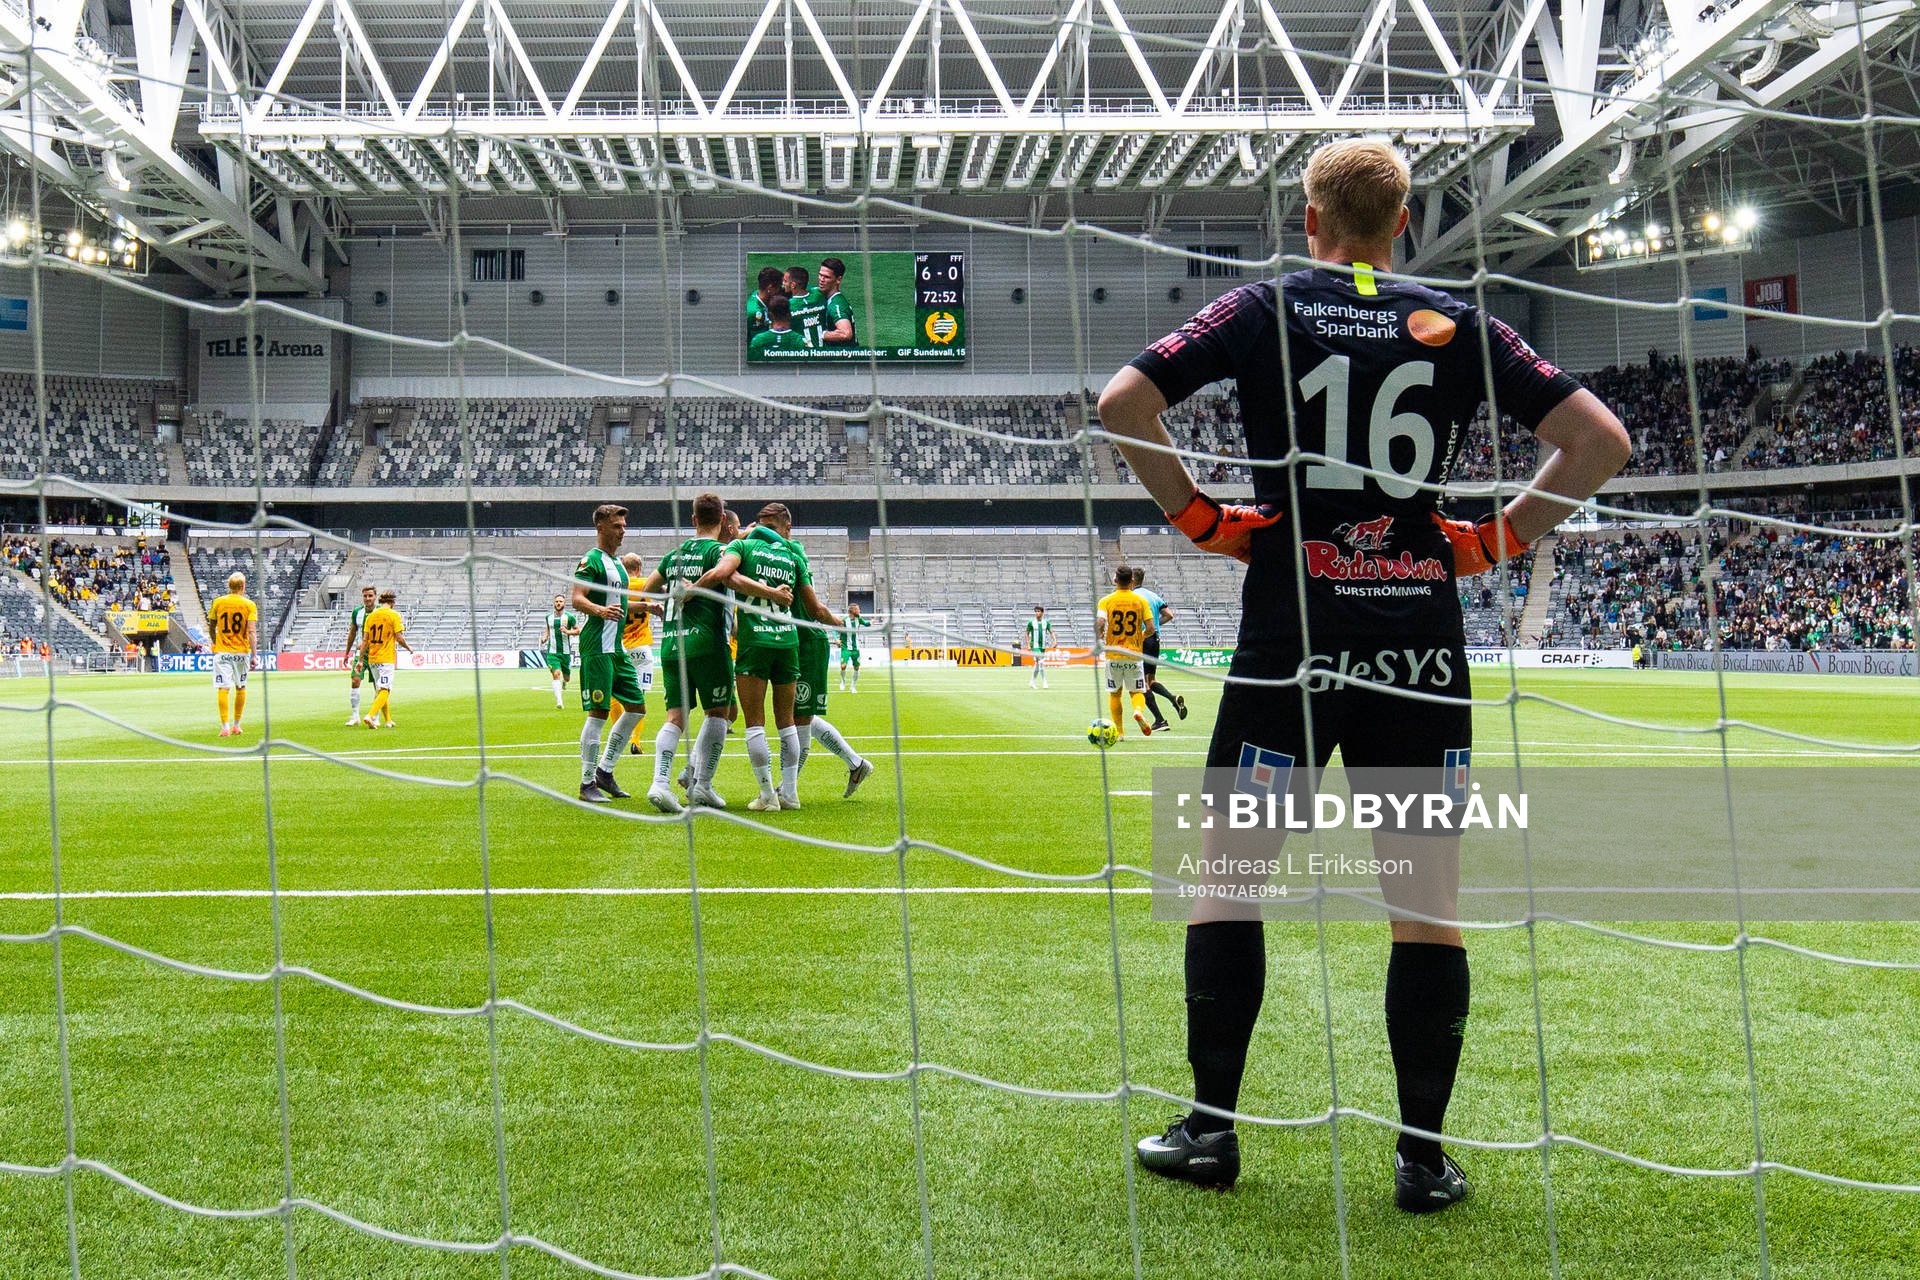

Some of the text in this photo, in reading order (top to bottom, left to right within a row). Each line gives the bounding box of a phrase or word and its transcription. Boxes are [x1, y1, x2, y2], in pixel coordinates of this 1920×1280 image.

[922, 266, 931, 280] 6
[948, 266, 958, 280] 0
[923, 291, 957, 303] 72:52
[1756, 282, 1782, 303] JOB
[1293, 301, 1398, 324] Falkenbergs
[1315, 319, 1399, 339] Sparbank
[206, 335, 324, 357] TELE2 Arena
[764, 349, 809, 357] Kommande
[810, 349, 887, 358] Hammarbymatcher:
[956, 348, 966, 356] 15
[1298, 354, 1435, 499] 16
[1439, 420, 1459, 485] Nyheter
[1301, 540, 1377, 580] Röda
[1334, 584, 1432, 597] SURSTRÖMMING
[220, 612, 243, 634] 18
[369, 623, 384, 644] 11
[1112, 610, 1138, 637] 33
[173, 655, 198, 671] THE
[426, 653, 491, 665] LILYS BURGER
[1541, 654, 1590, 665] CRAFT
[1787, 655, 1804, 672] AB
[1828, 654, 1913, 676] BODIN BYGG &
[1303, 648, 1453, 693] GleSYS
